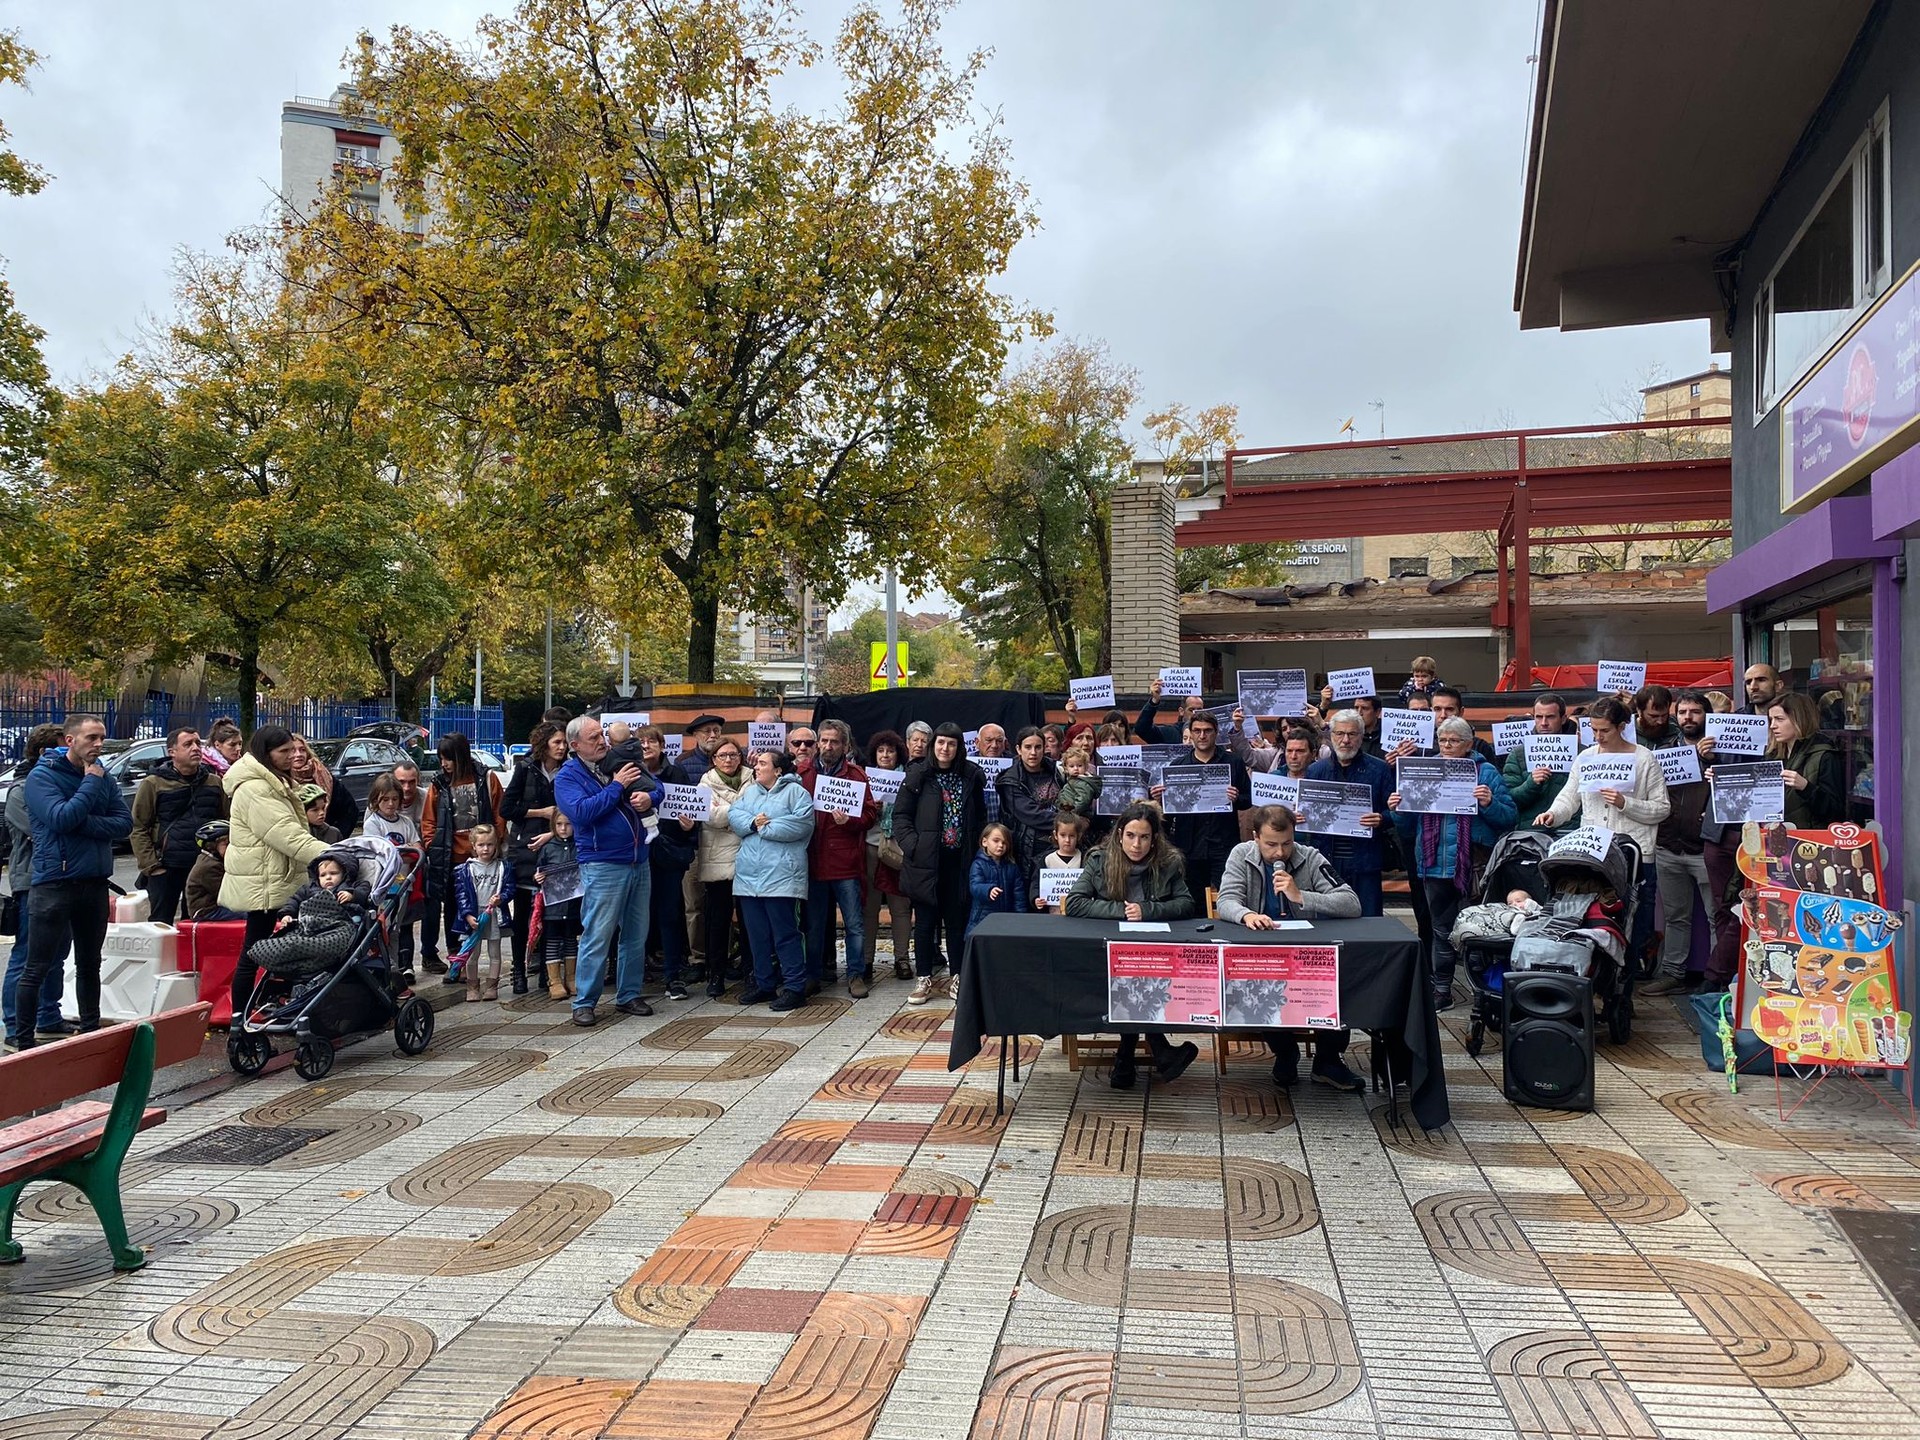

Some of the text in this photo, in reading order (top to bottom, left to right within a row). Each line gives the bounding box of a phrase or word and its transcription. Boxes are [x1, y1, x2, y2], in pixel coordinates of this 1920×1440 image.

[1311, 543, 1347, 553] SEÑORA
[1285, 556, 1320, 565] HUERTO
[1600, 664, 1644, 672] DONIBANEKO
[1330, 670, 1370, 680] DONIBANEKO
[1072, 684, 1111, 694] DONIBANEN
[1075, 692, 1110, 701] EUSKARAZ
[1383, 712, 1432, 721] DONIBANEKO
[1708, 718, 1766, 726] DONIBANEKO
[1392, 728, 1420, 736] ESKOLA
[1387, 735, 1426, 744] EUSKRAZ
[1498, 739, 1523, 747] EUSKA
[1713, 743, 1759, 751] EUSKARAZ
[1656, 749, 1693, 760] IBANEKO
[978, 758, 999, 766] HAUR
[1581, 764, 1633, 773] DONIBANEN
[867, 776, 902, 787] DONIBANE
[1583, 773, 1629, 781] EUSKARAZ
[1665, 773, 1693, 782] KARAZ
[829, 779, 852, 789] HAUR
[1253, 782, 1297, 793] DONIBANEN
[674, 786, 697, 794] HAUR
[821, 786, 857, 798] ESKOLAK
[870, 785, 898, 794] USKARA
[667, 794, 704, 803] ESKOLAK
[1255, 790, 1294, 801] EUSKARAZ
[817, 794, 859, 807] EUSKARAZ
[663, 802, 706, 811] EUSKARAZ
